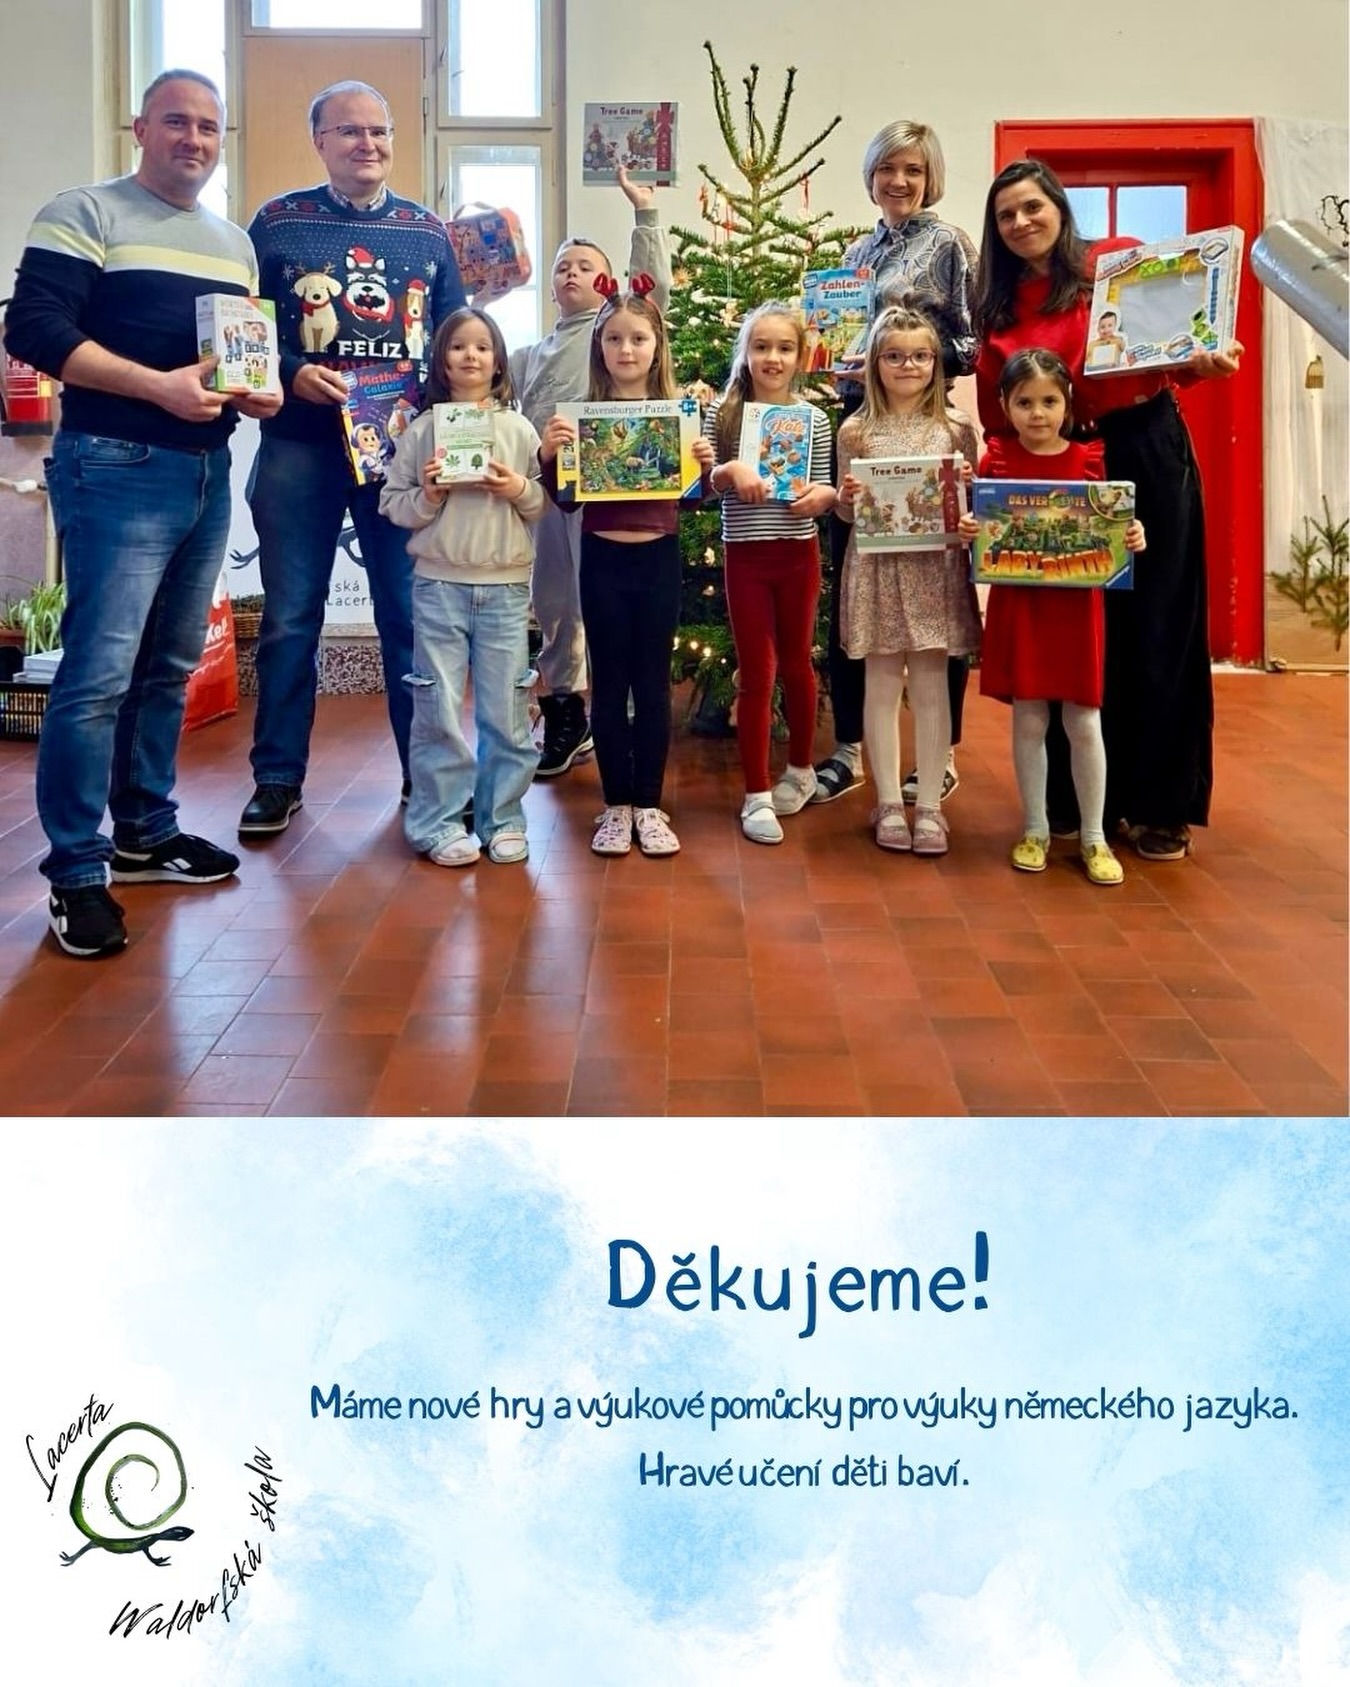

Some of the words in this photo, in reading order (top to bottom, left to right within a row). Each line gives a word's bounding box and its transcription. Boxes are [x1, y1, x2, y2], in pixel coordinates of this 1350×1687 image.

[600, 106, 618, 116] Tree
[620, 106, 643, 116] Game
[821, 280, 865, 290] Zahlen-
[824, 290, 861, 299] Zauber
[337, 340, 403, 358] FELIZ
[584, 405, 642, 416] Ravensburger
[645, 404, 672, 414] Puzzle
[870, 466, 891, 476] Tree
[893, 464, 922, 475] Game
[1008, 494, 1027, 506] DAS
[982, 548, 1113, 581] LABYRINTH
